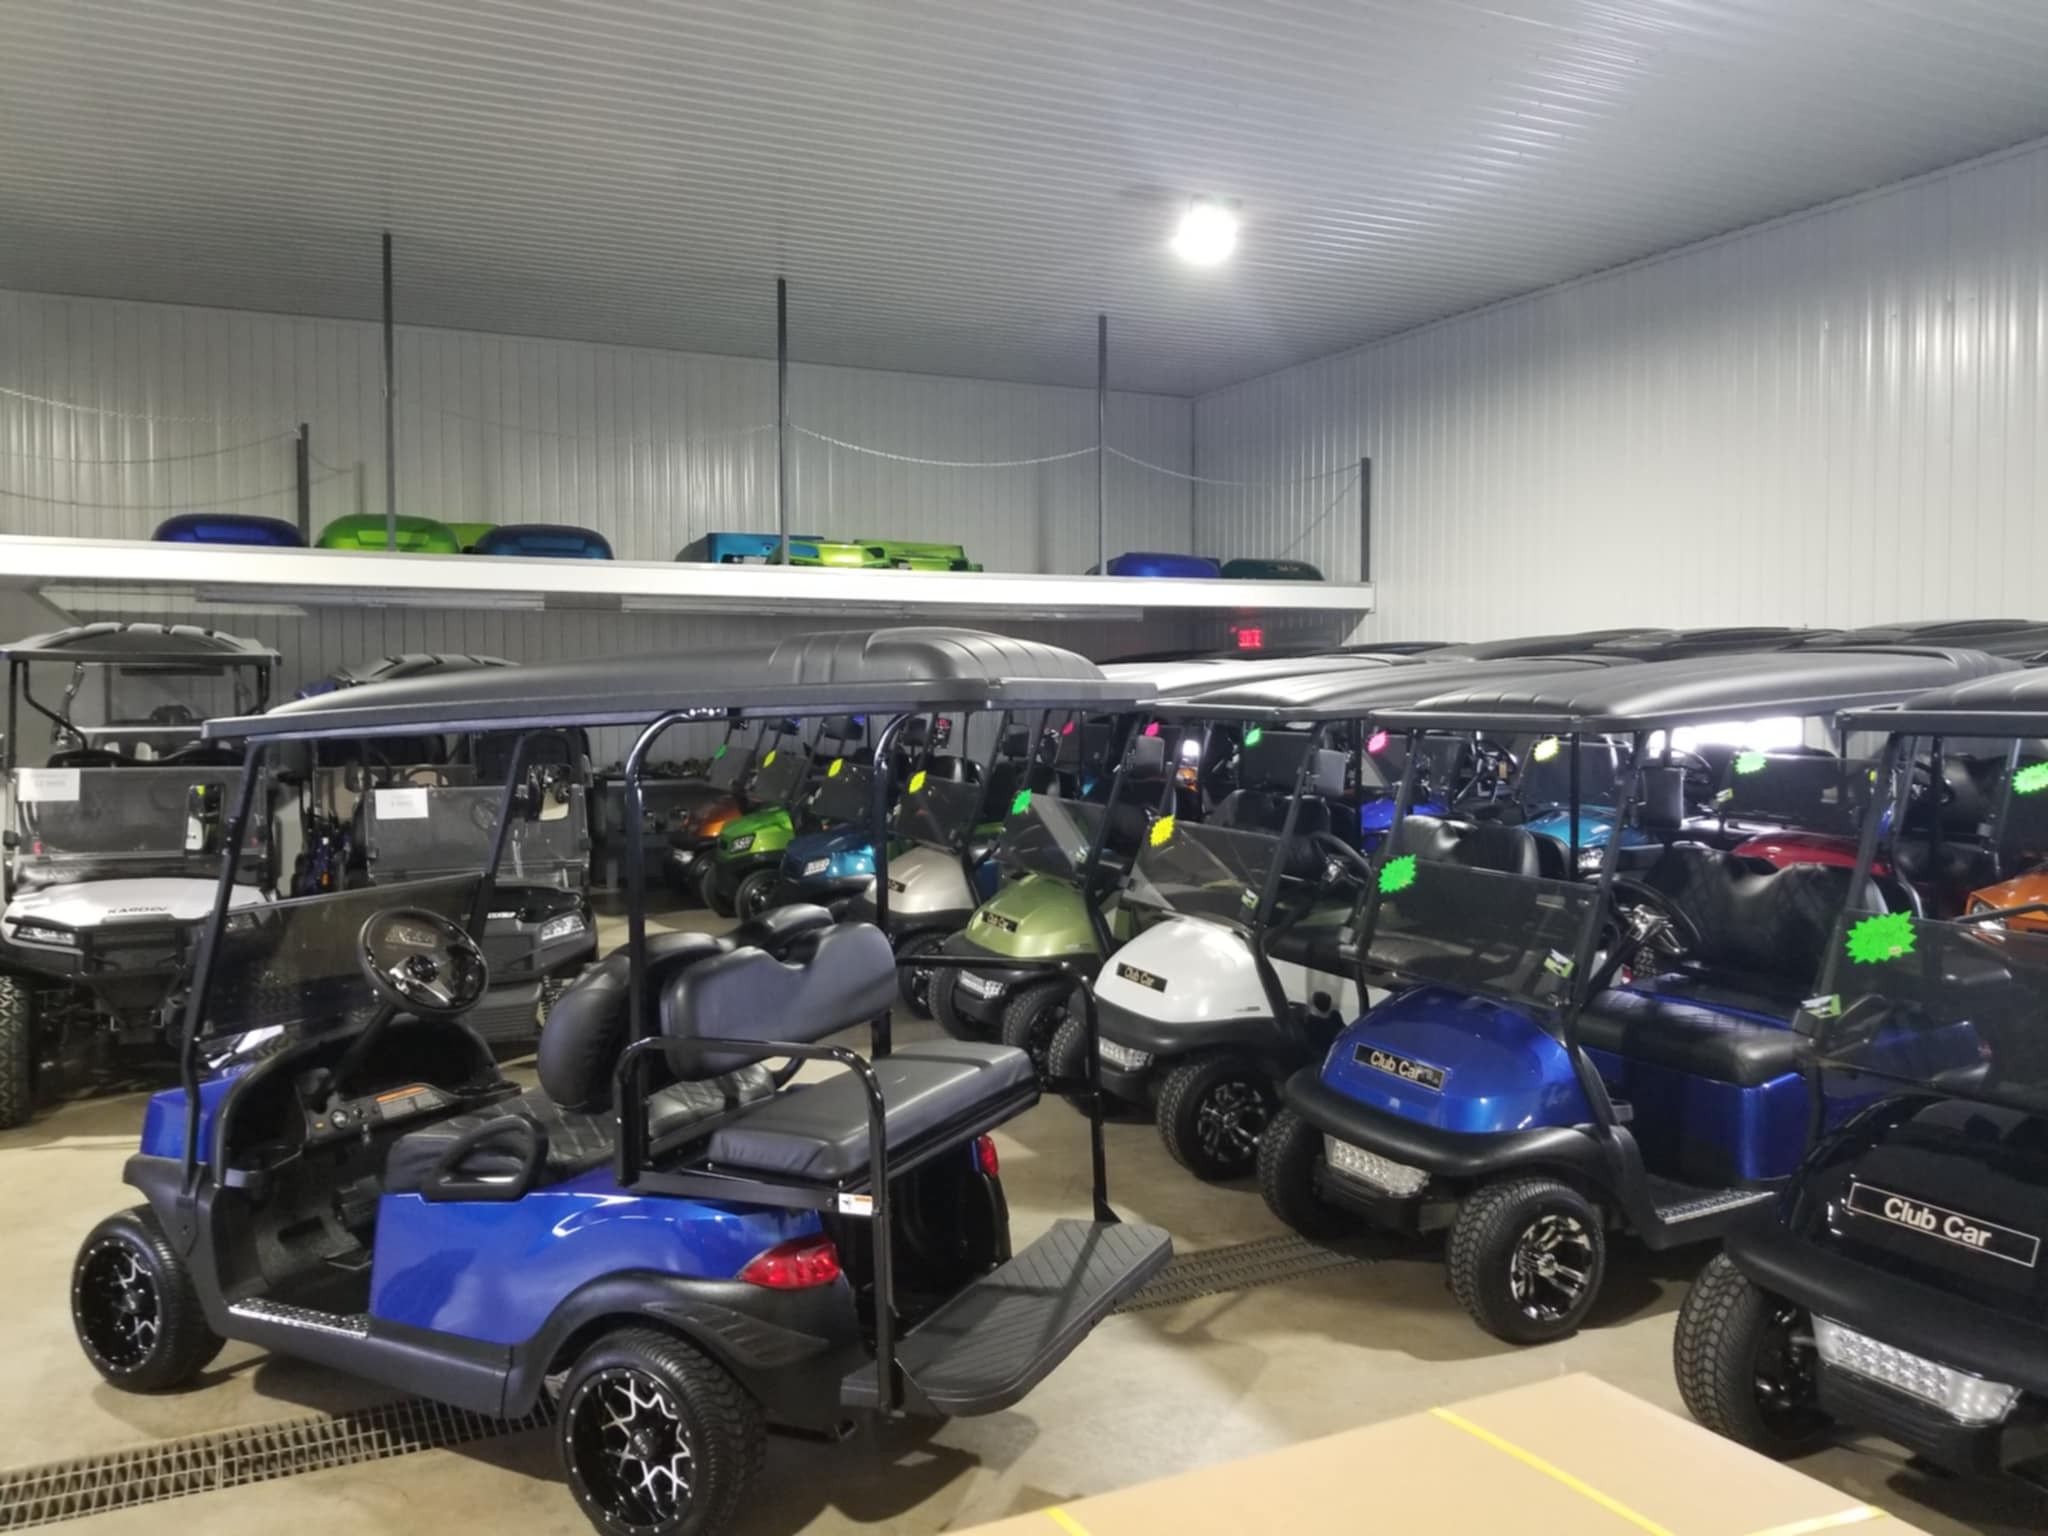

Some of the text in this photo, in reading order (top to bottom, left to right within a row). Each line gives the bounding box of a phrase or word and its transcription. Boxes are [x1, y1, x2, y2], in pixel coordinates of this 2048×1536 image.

[1370, 1051, 1423, 1081] Club Car
[1884, 1197, 1993, 1247] Club Car
